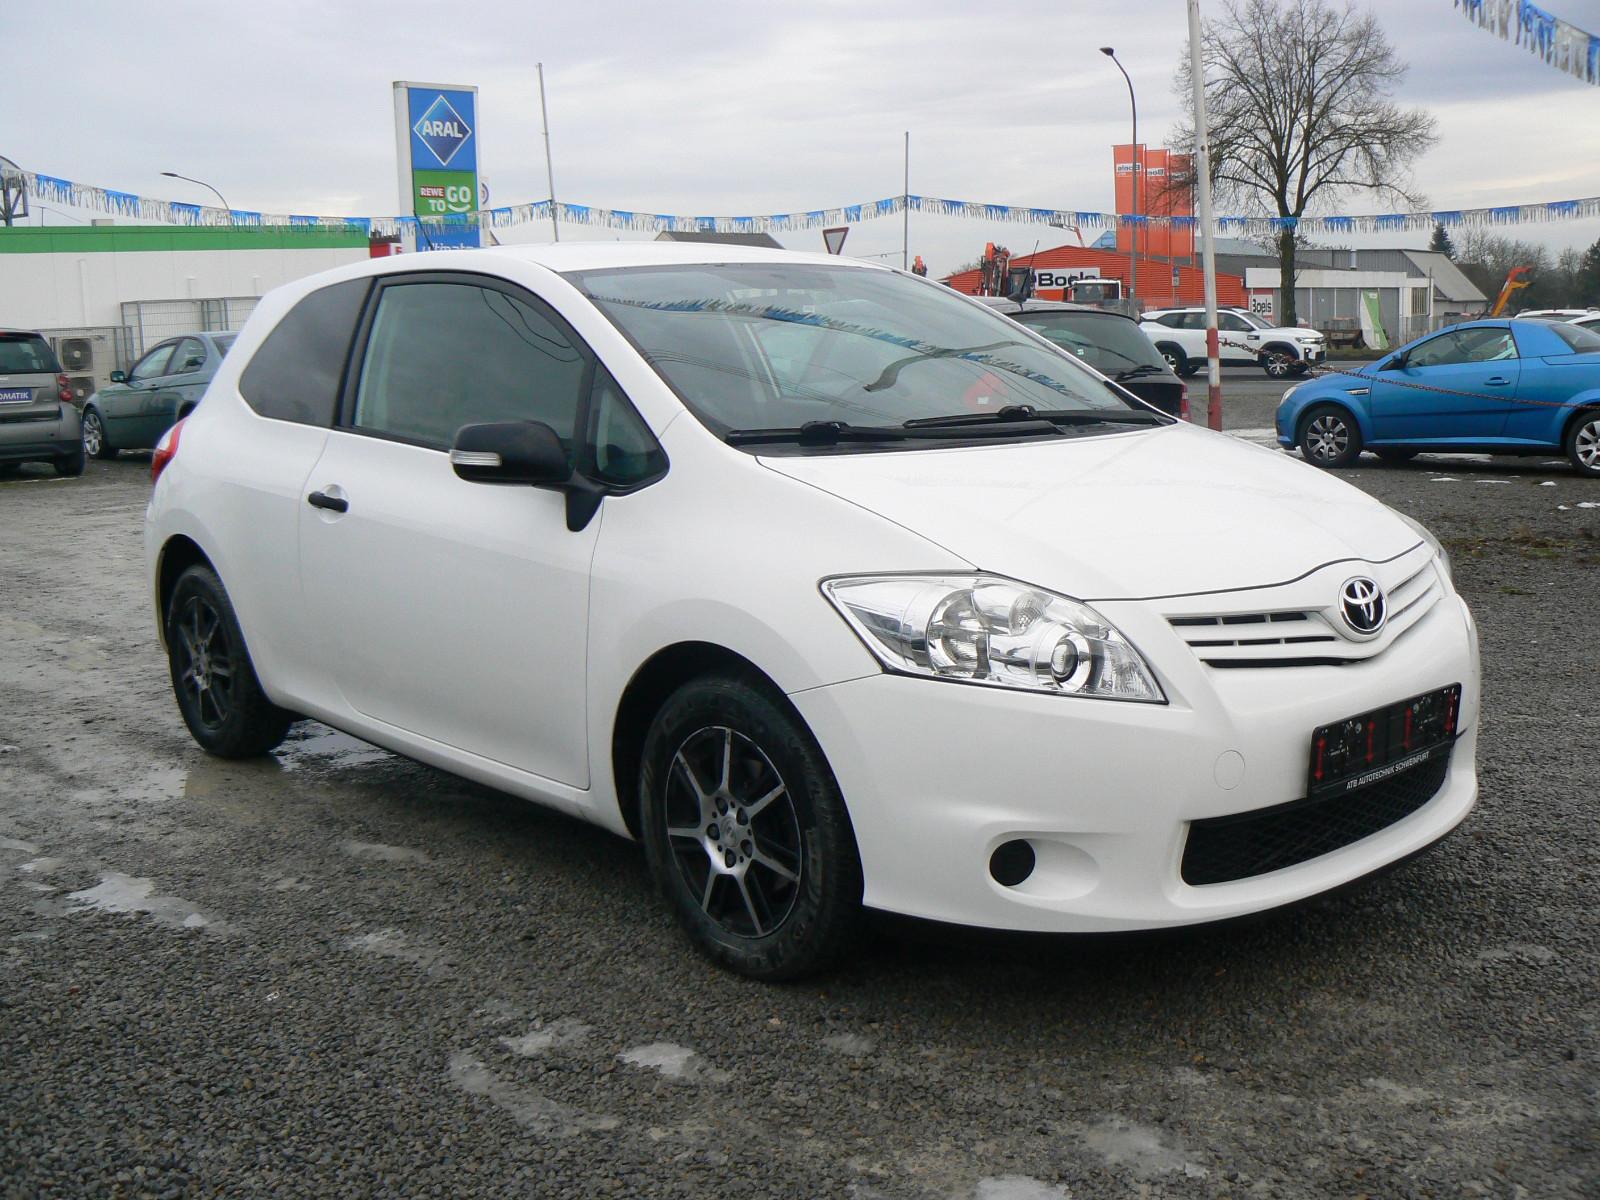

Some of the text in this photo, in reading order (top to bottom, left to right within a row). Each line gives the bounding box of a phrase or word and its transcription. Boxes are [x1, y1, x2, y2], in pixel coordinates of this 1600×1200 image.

[422, 120, 463, 138] ARAL
[421, 188, 444, 197] REWE
[447, 186, 471, 203] GO
[429, 200, 446, 212] TO
[1252, 298, 1272, 312] Boels
[1346, 751, 1430, 790] ATB AUTOTECHNIK SCHWEINFURT
